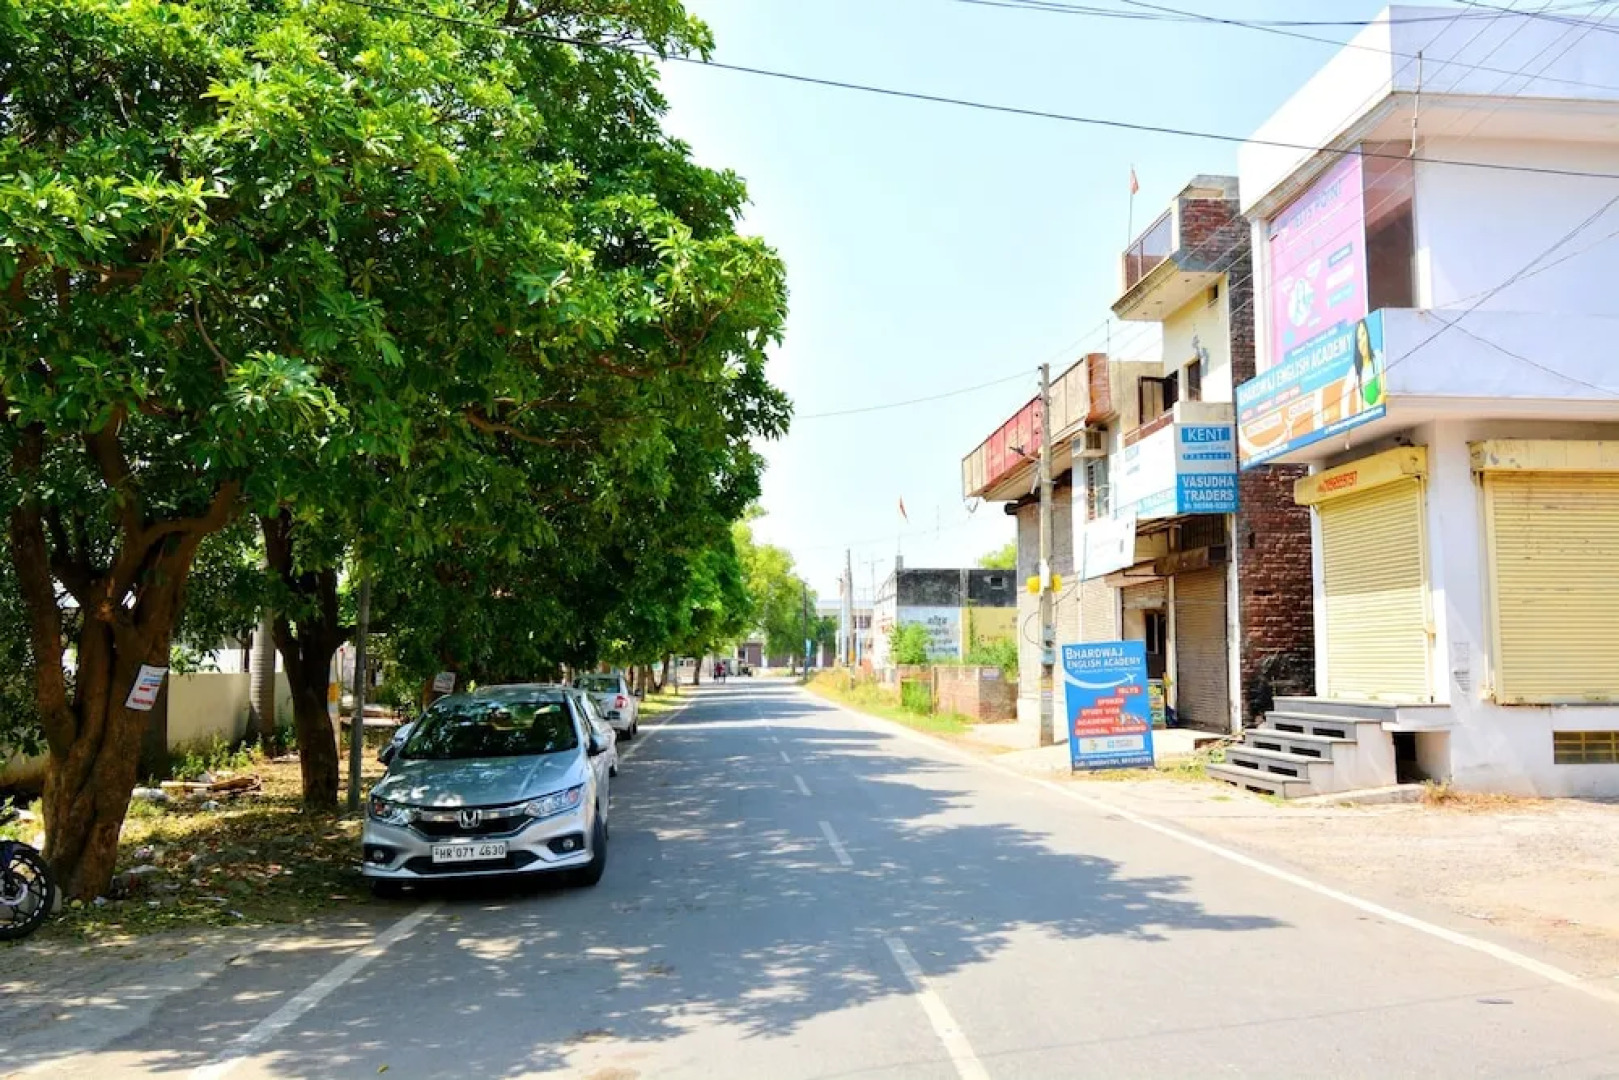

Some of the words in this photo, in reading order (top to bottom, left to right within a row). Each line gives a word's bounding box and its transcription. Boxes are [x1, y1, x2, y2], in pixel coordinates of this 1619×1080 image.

[1311, 332, 1351, 366] ACADEMY
[1188, 428, 1223, 440] KENT
[1181, 476, 1234, 487] VASUDHA
[1184, 489, 1234, 501] TRADERS
[1066, 647, 1123, 660] BHARDWAJ
[1067, 659, 1102, 670] ENGLISH
[1103, 656, 1141, 666] ACADEMY
[479, 844, 505, 856] 4630
